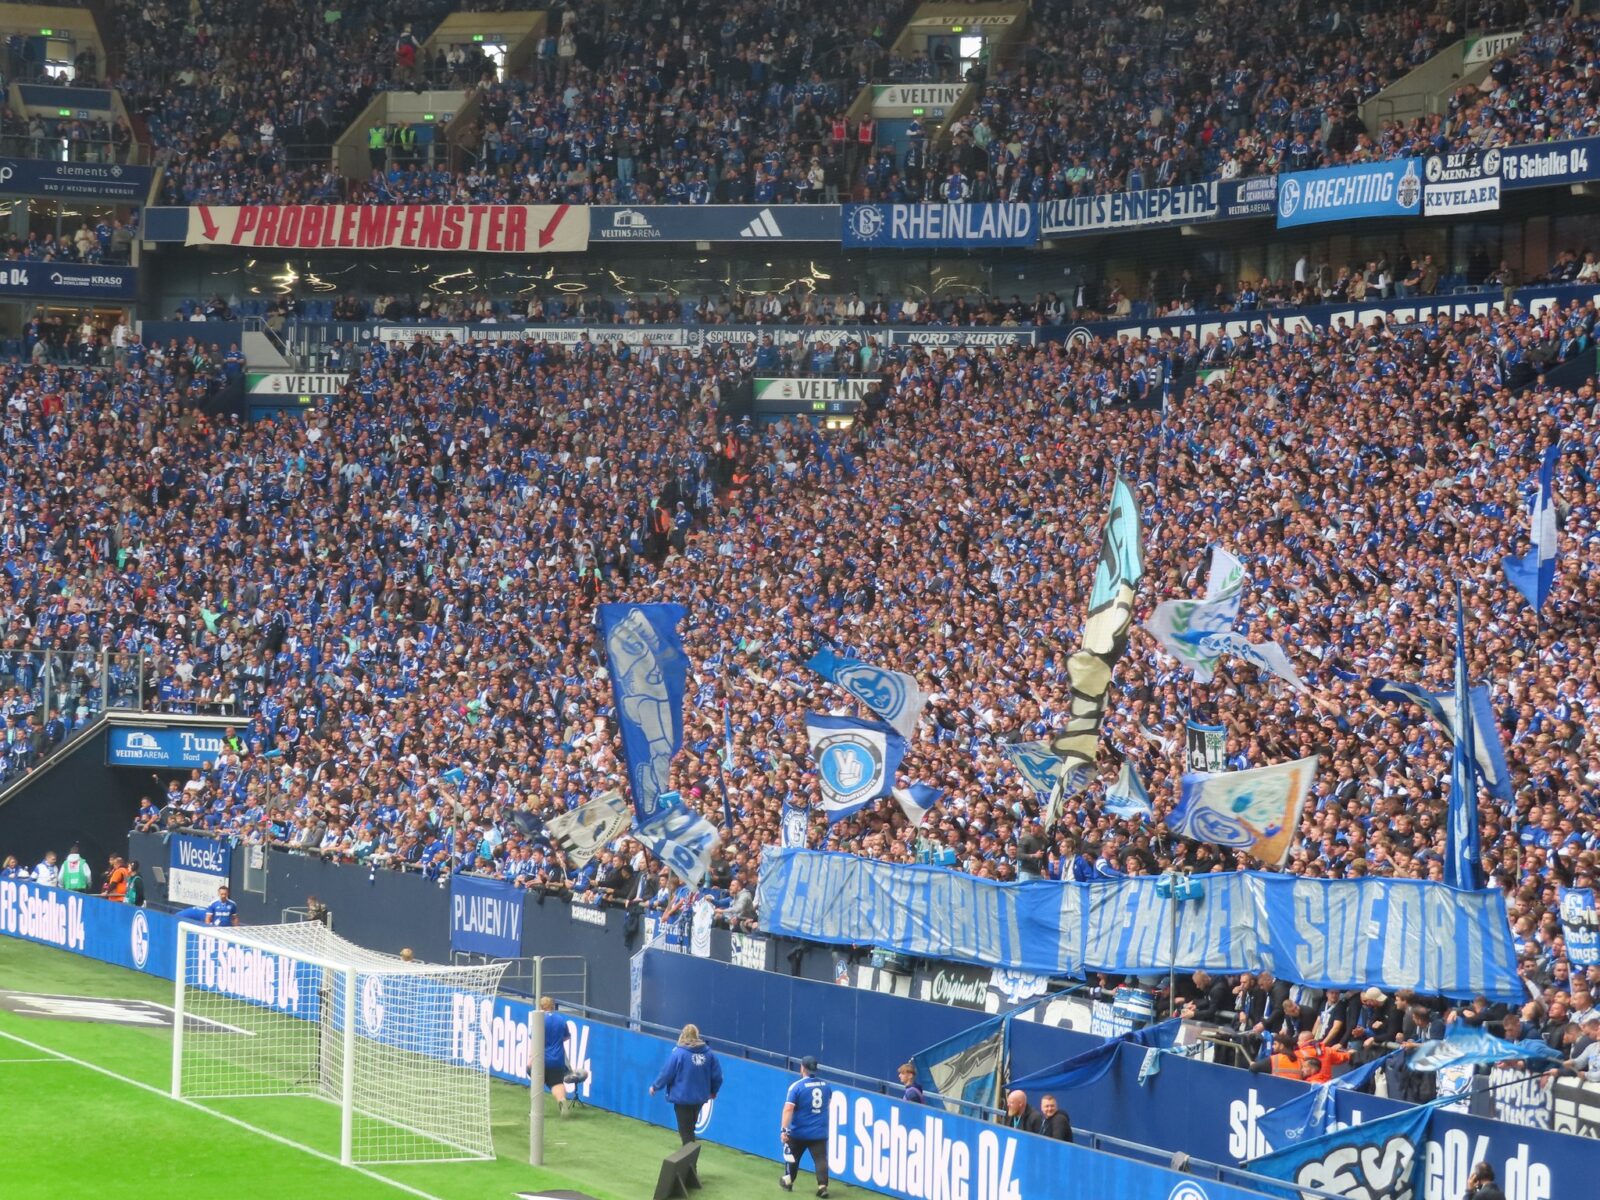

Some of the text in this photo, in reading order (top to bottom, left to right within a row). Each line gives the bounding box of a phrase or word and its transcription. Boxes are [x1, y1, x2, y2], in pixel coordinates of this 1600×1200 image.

[942, 16, 1009, 25] VELTINS
[57, 166, 108, 177] elements
[1503, 148, 1588, 180] FC Schalke 04
[67, 185, 97, 193] HEIZUNG
[1303, 172, 1394, 210] KRECHTING
[1426, 186, 1498, 207] KEVELAER
[1111, 182, 1216, 220] ENNEPETAL
[1228, 203, 1270, 215] VELTINS ARENA
[231, 205, 527, 251] PROBLEMFENSTER
[892, 204, 1030, 239] RHEINLAND
[601, 229, 661, 238] VELTINS ARENA
[10, 268, 29, 286] 04
[91, 276, 122, 285] KRASO
[596, 332, 623, 341] NORD
[711, 331, 752, 343] SCHALKE
[908, 333, 1018, 345] NORD KURVE
[286, 376, 349, 393] VELTIN
[116, 750, 169, 759] VELTINS ARENA
[183, 753, 200, 761] Nord
[0, 880, 85, 950] FC Schalke 04
[454, 894, 501, 937] PLAUEN
[1293, 881, 1523, 997] SOFORT!
[198, 934, 299, 1012] FC Schalke 04
[932, 969, 979, 1006] Original
[452, 992, 475, 1063] FC
[480, 998, 533, 1080] Scha
[812, 1088, 823, 1108] 8
[854, 1097, 970, 1200] Schalke
[979, 1130, 1020, 1200] 04
